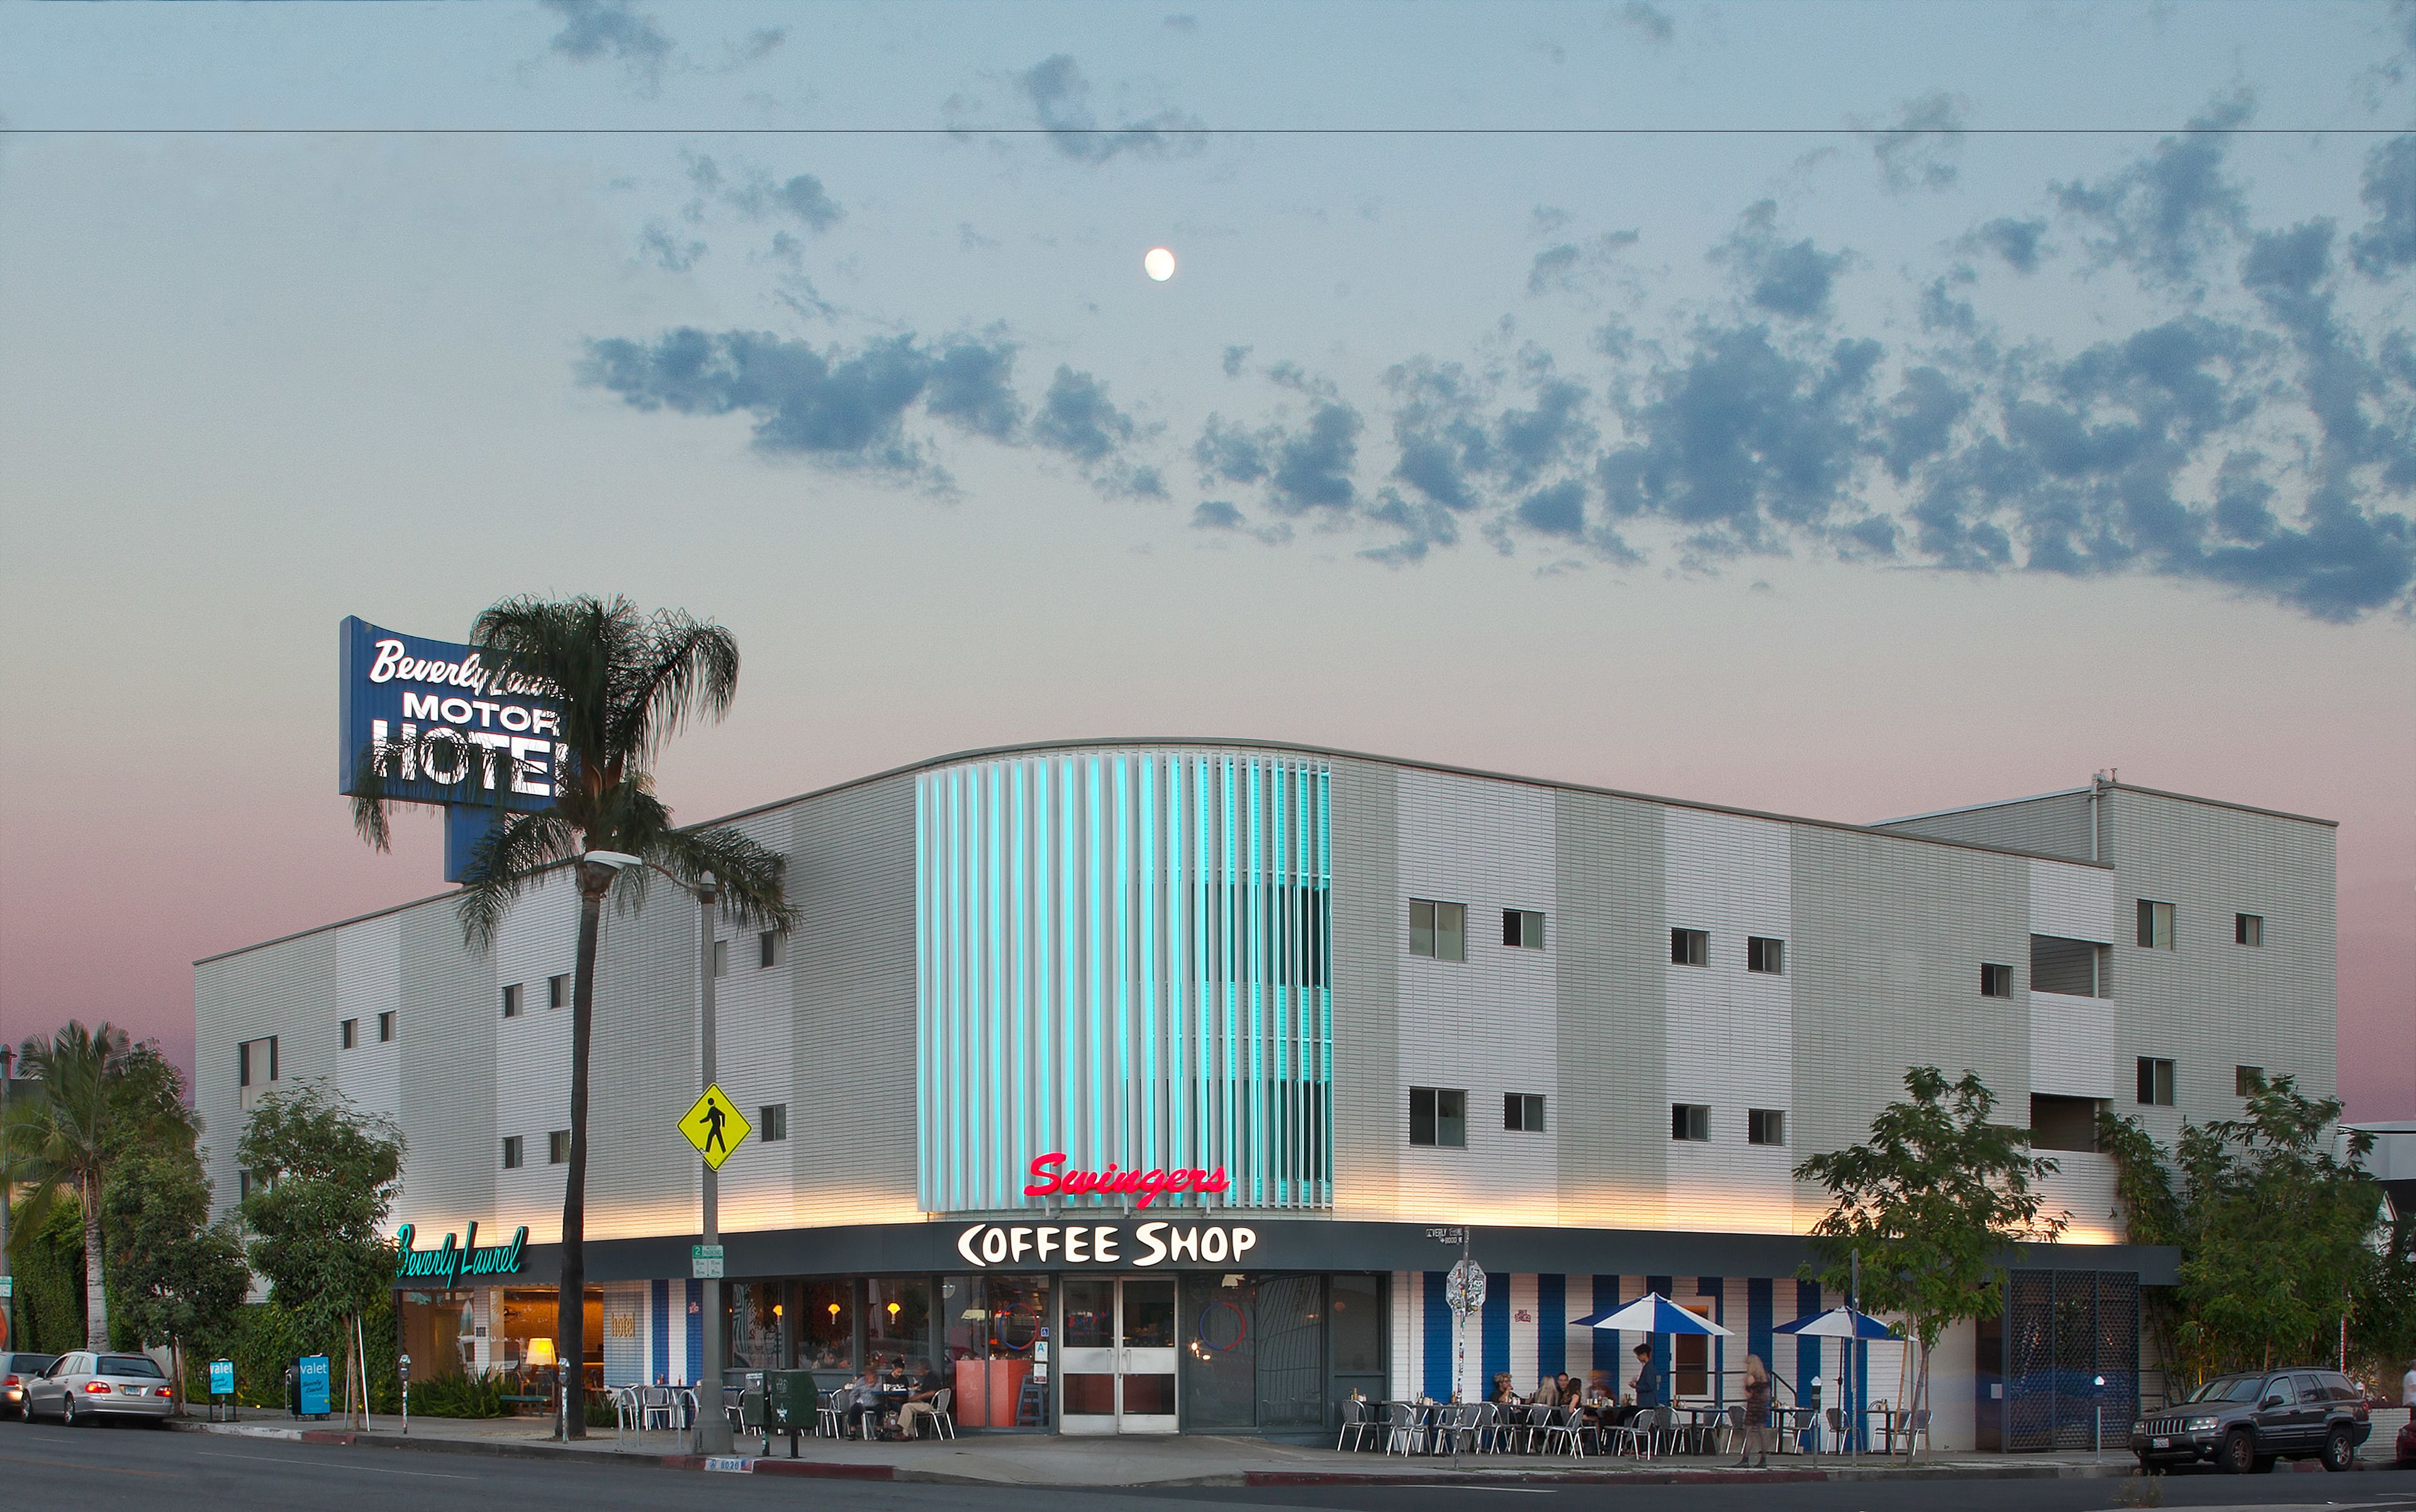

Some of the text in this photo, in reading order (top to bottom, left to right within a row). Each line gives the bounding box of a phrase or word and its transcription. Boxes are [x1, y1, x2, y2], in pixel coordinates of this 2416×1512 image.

[370, 638, 491, 696] Beverly
[403, 691, 561, 737] MOTOR
[1024, 1152, 1230, 1209] Swingers
[396, 1221, 522, 1289] Beverly Laurel
[695, 1246, 700, 1255] 2
[958, 1222, 1257, 1267] COFFEE SHOP
[611, 1312, 635, 1338] hotel
[1037, 1343, 1044, 1352] A
[210, 1362, 233, 1374] valet
[300, 1362, 328, 1374] valet
